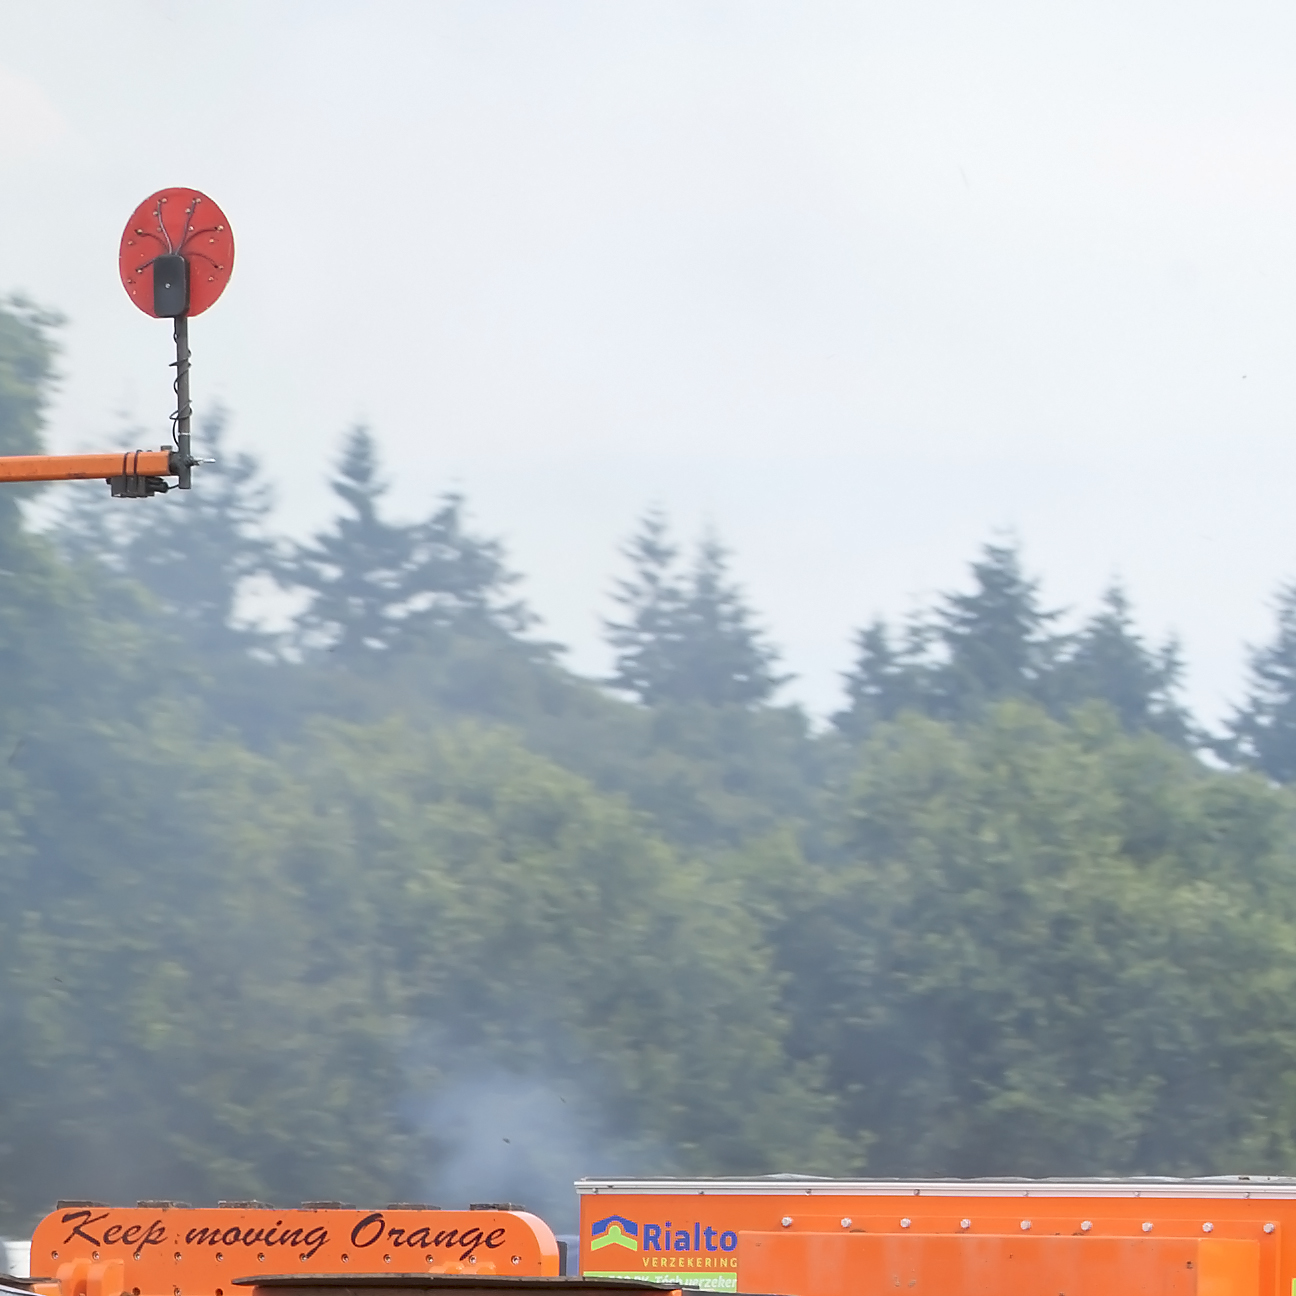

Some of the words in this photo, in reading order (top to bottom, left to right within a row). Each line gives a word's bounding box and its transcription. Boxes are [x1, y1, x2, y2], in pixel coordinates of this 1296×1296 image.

[61, 1210, 167, 1253] Keep
[185, 1219, 331, 1261] moving
[350, 1212, 506, 1262] Orange
[643, 1221, 738, 1252] Rialto
[642, 1257, 738, 1268] VERZEKERING
